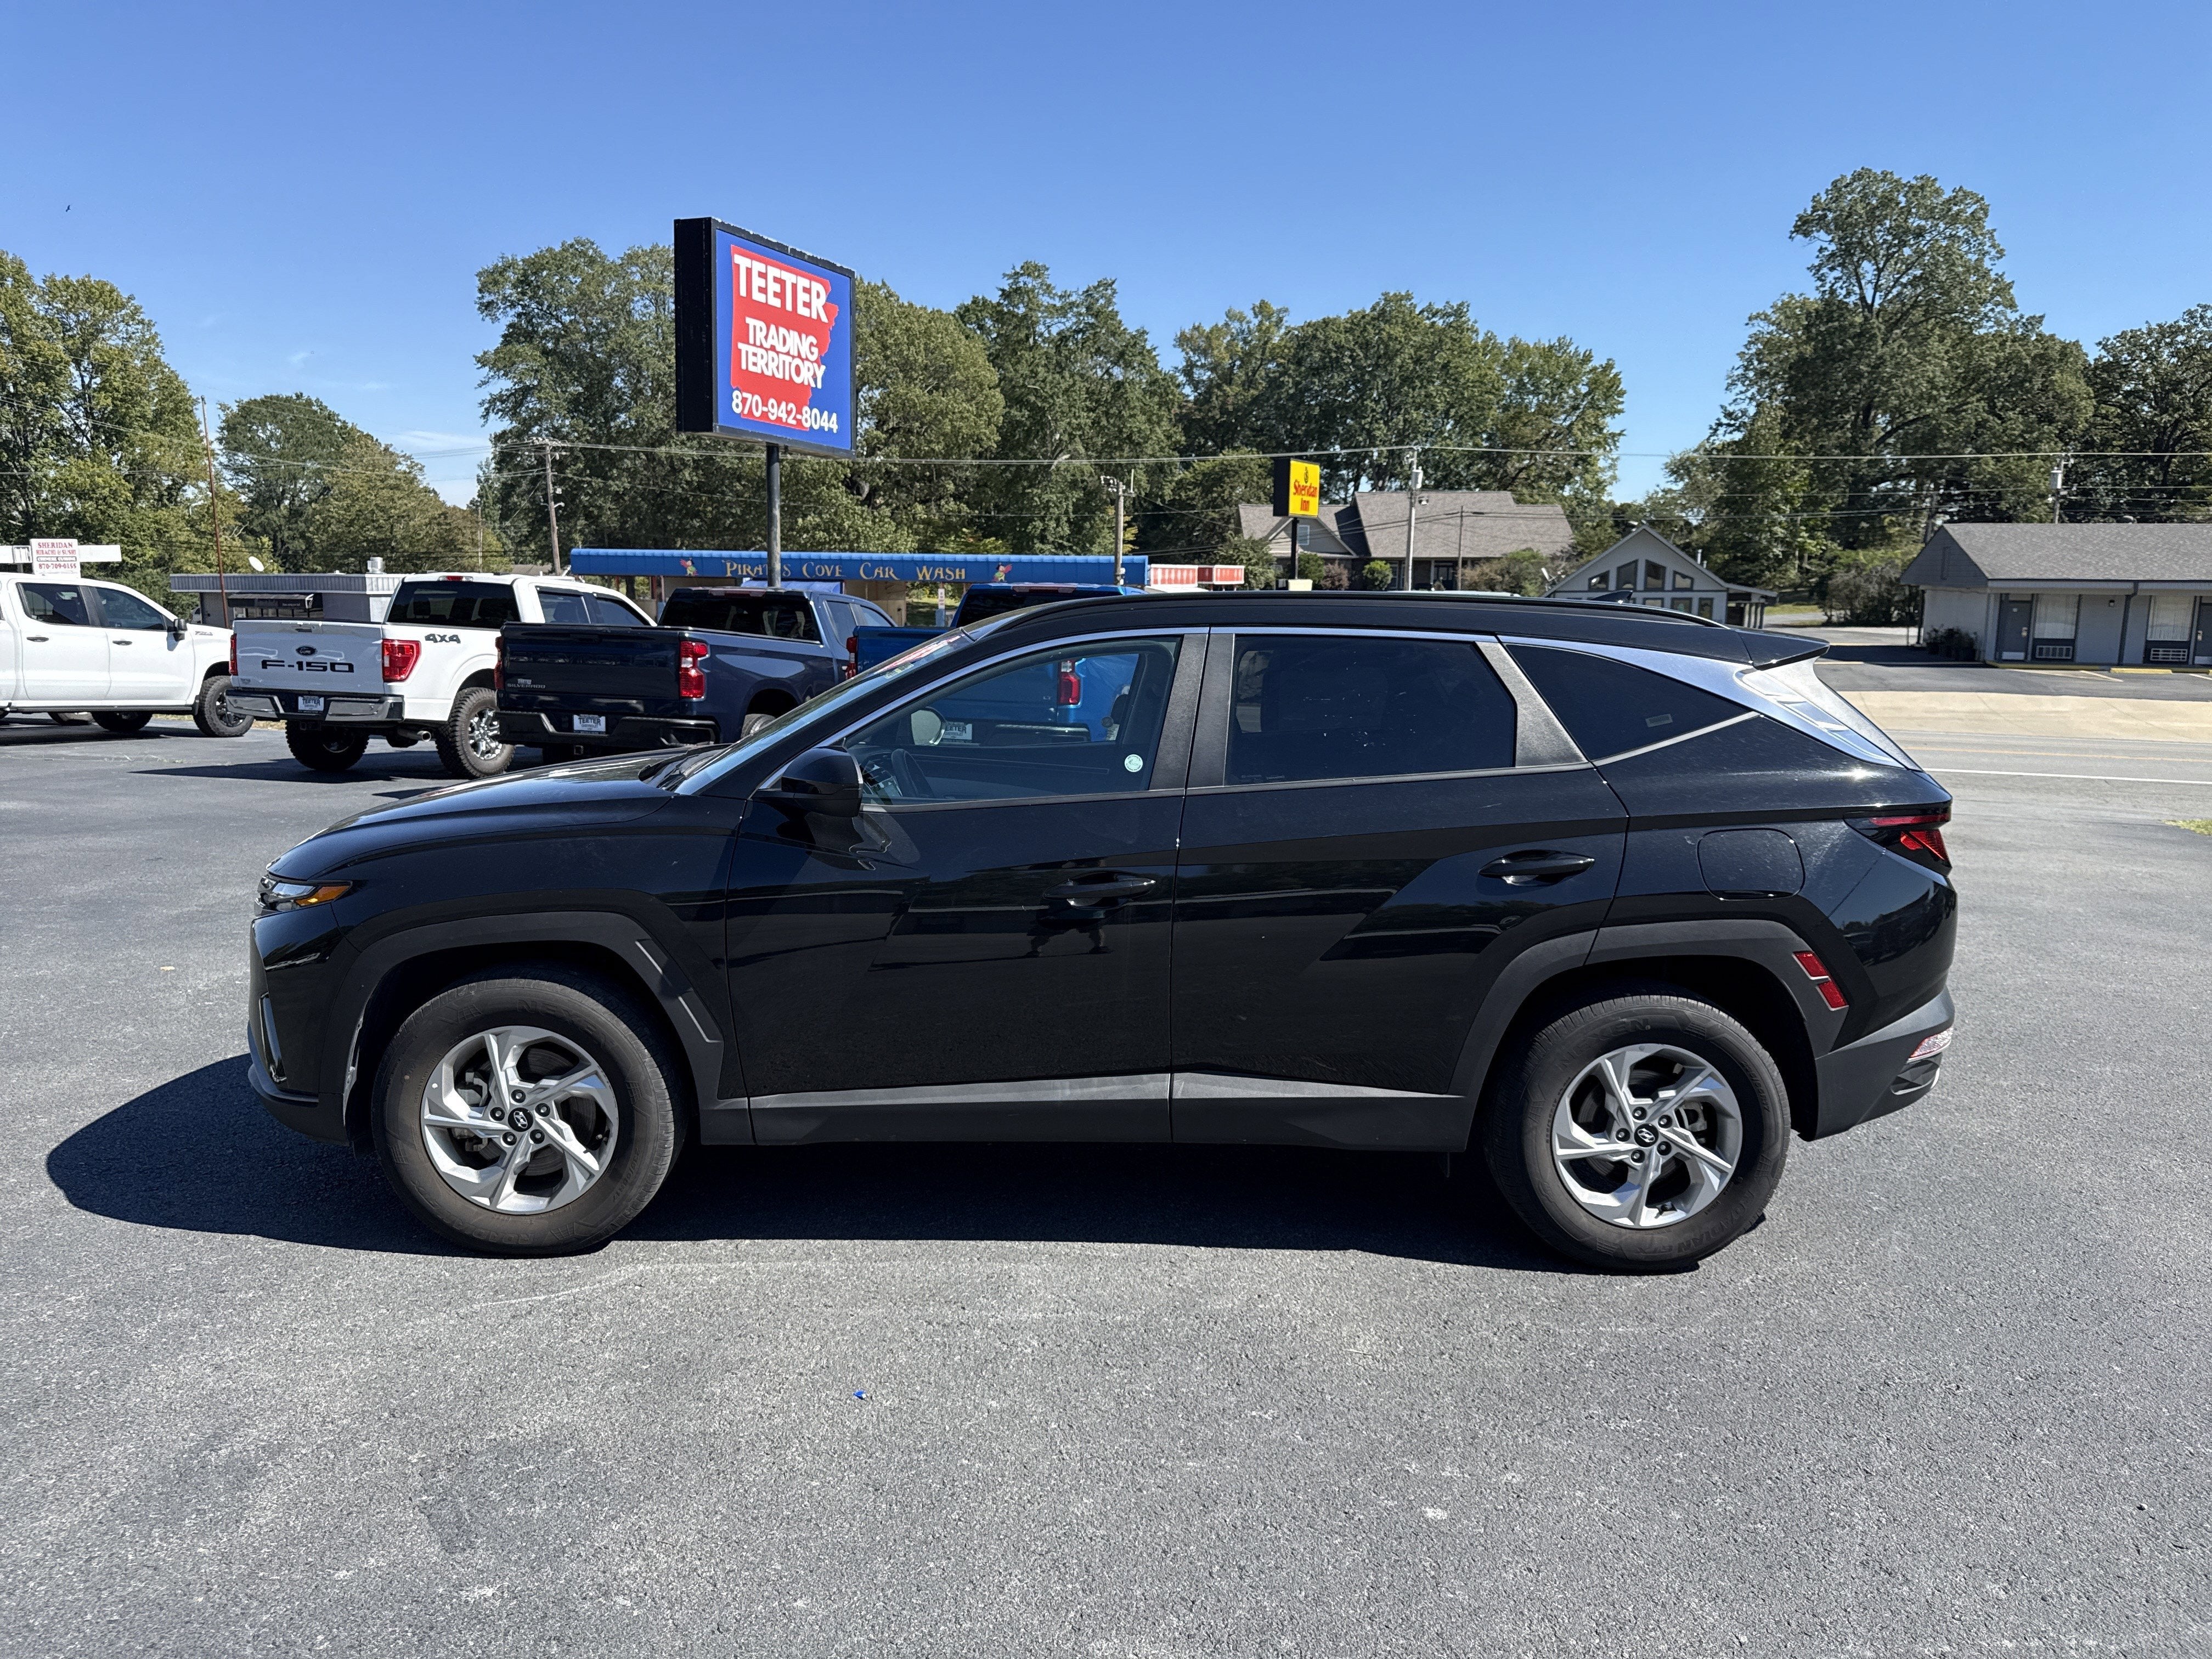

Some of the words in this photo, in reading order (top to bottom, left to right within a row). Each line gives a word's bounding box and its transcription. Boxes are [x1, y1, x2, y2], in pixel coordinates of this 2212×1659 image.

[733, 253, 829, 323] TEETER
[745, 317, 819, 362] TRADING
[737, 341, 827, 390] TERRITORY
[731, 390, 839, 434] 870-942-8044
[1293, 479, 1317, 498] Sheridan
[1300, 498, 1310, 511] Inn
[802, 561, 845, 579] COVE
[859, 562, 900, 580] CAR
[916, 565, 966, 581] WASH
[261, 659, 354, 673] F-150
[578, 716, 601, 726] TEETER
[517, 999, 617, 1053] NEXEN
